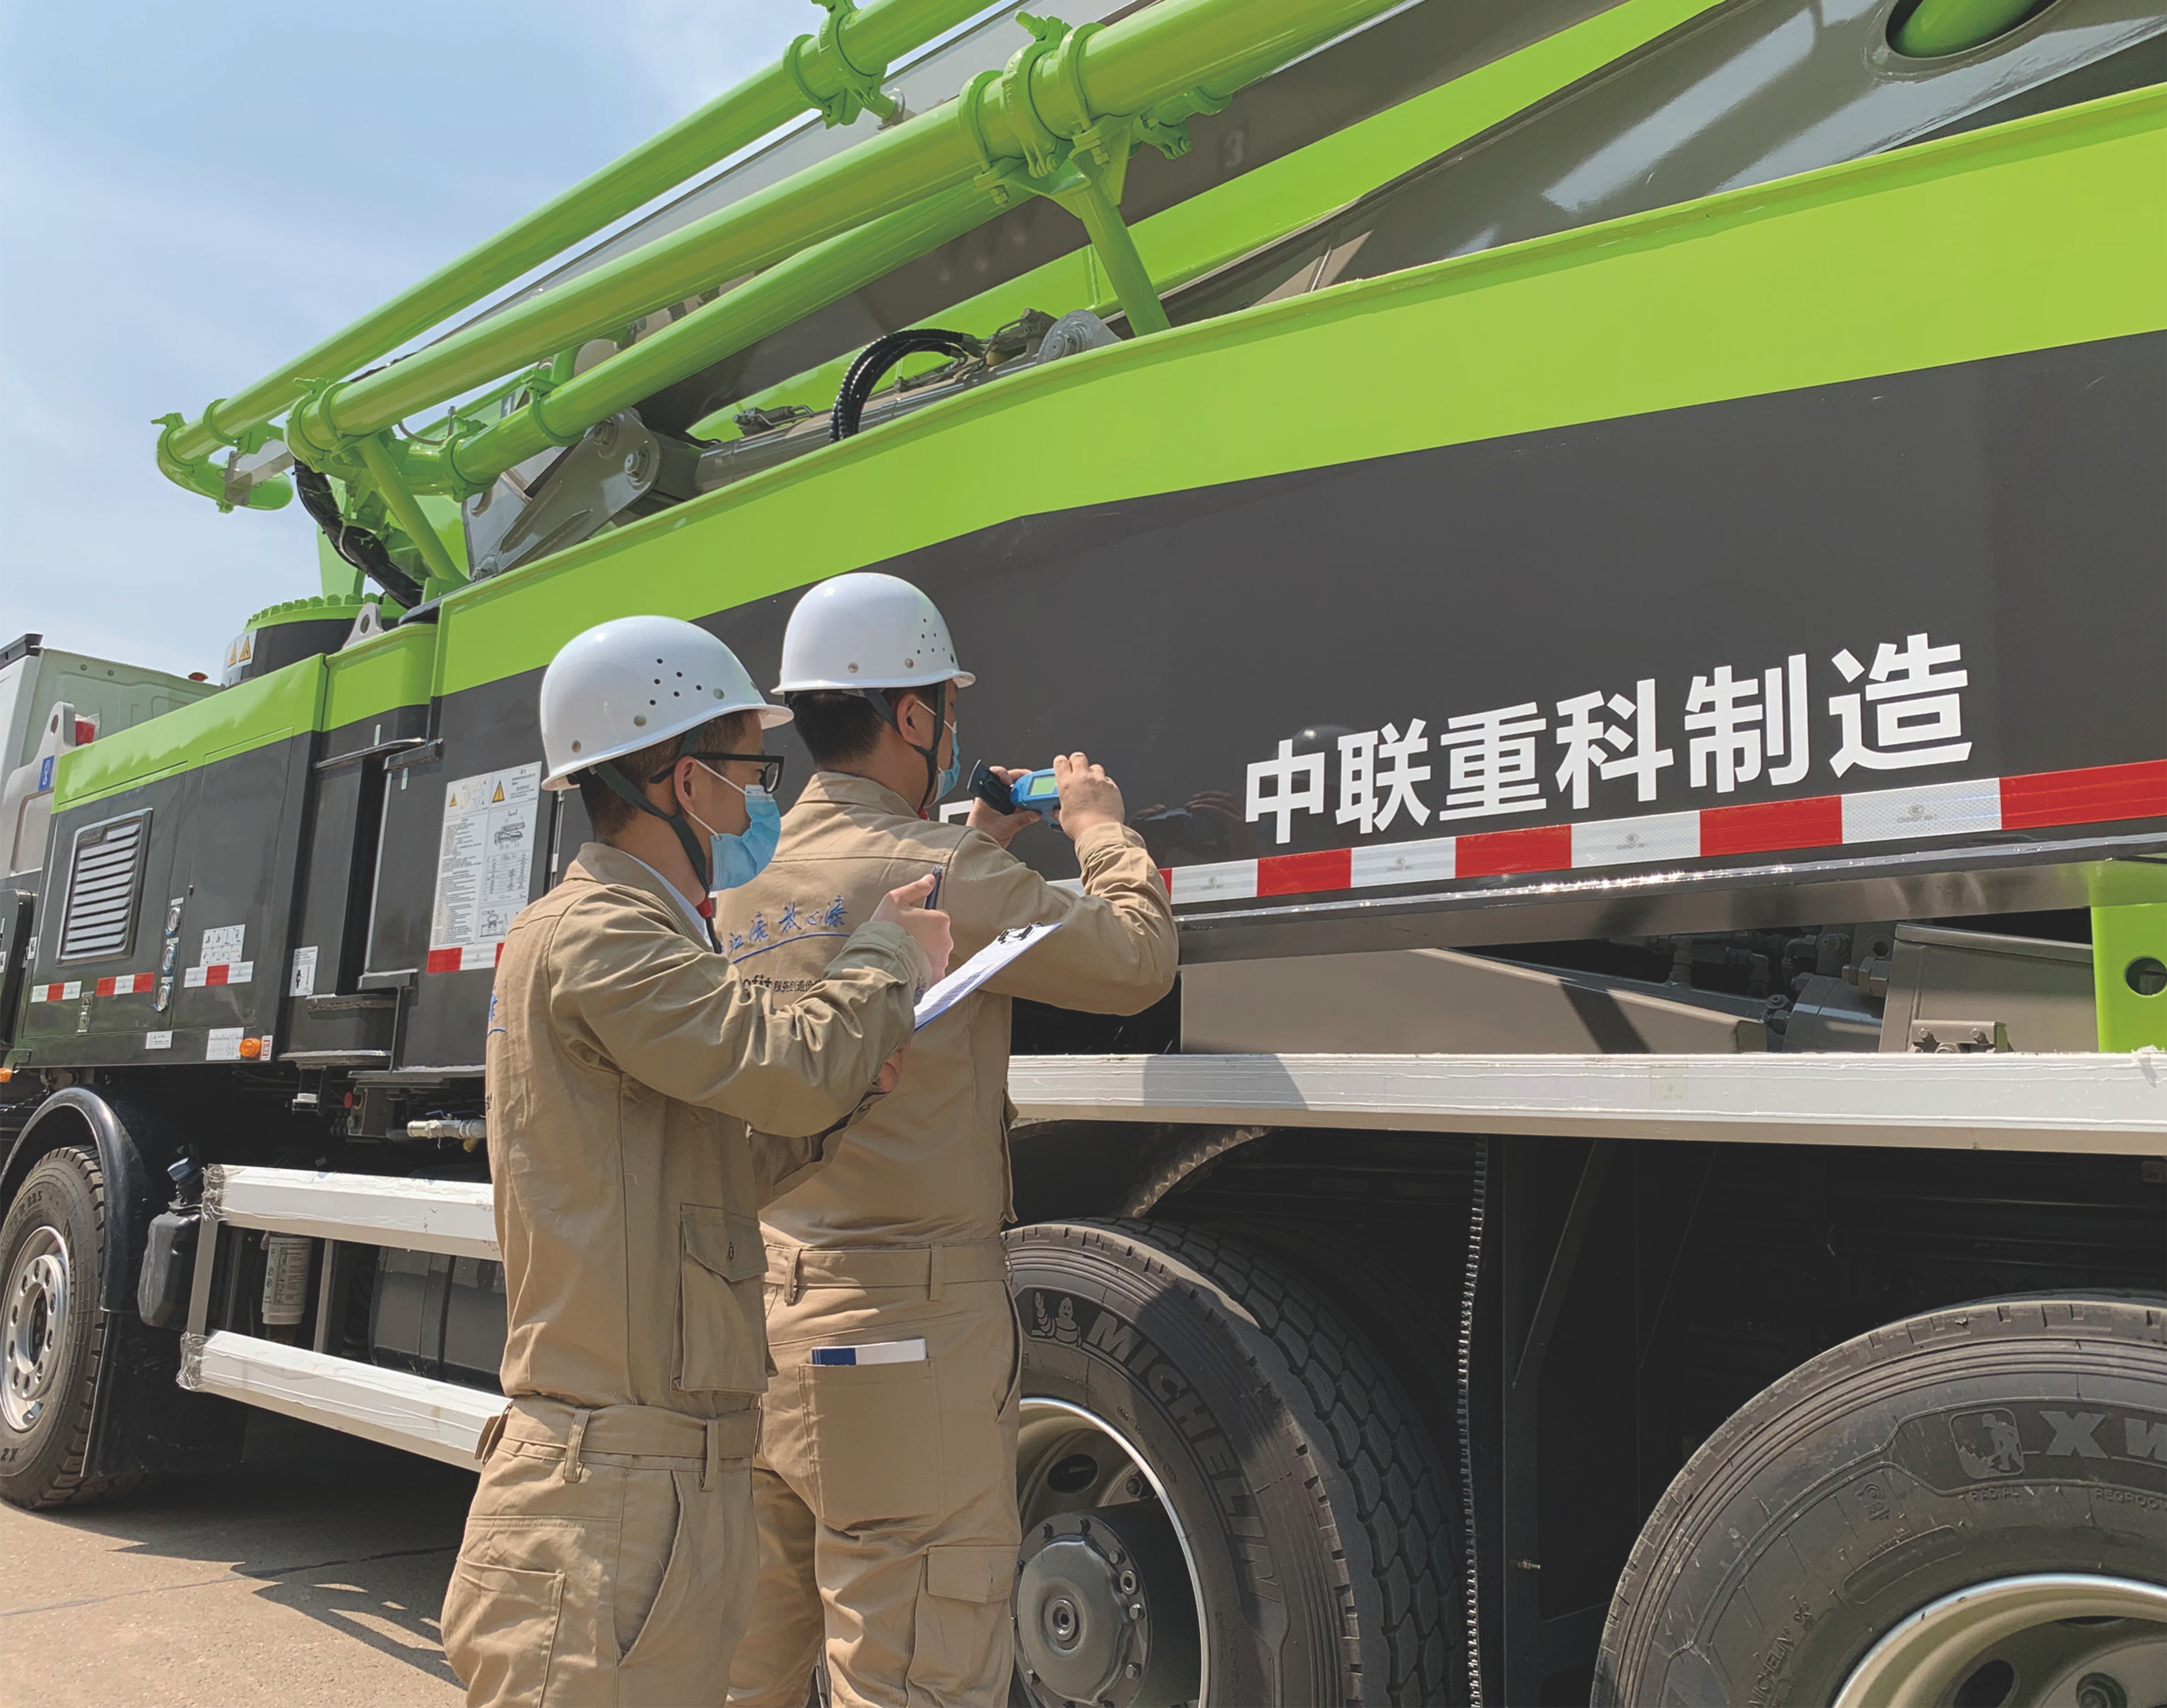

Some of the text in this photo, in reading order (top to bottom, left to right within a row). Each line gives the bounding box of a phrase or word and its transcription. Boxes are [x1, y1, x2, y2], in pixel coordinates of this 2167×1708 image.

[1246, 632, 1972, 844] 中联重科制造
[1086, 1311, 1281, 1602] MICHELIN
[1970, 1488, 2020, 1502] RADIAL
